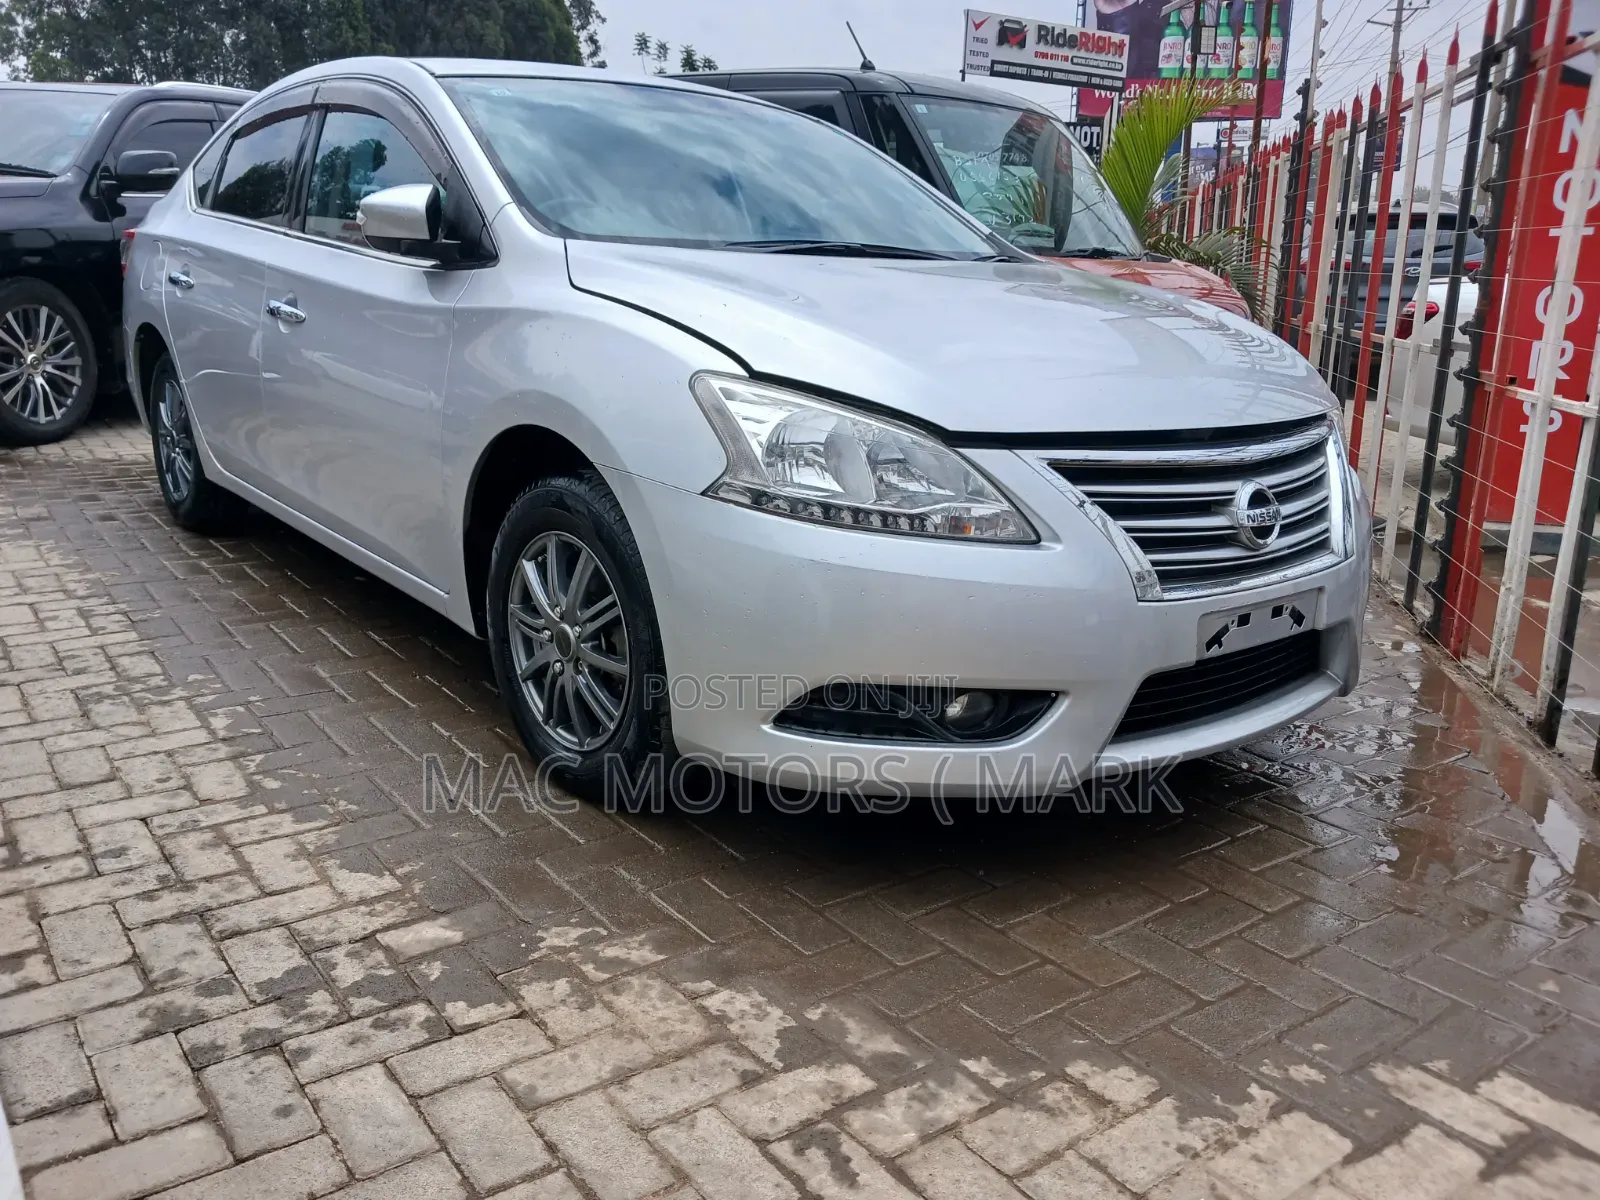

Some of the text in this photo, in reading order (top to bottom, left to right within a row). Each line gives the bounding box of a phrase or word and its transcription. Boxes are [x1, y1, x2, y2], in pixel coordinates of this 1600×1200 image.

[972, 36, 989, 45] TRIED
[1035, 24, 1127, 58] RideRight
[1163, 42, 1182, 51] JINRO
[969, 49, 990, 58] TESTED
[966, 63, 991, 72] TRUSTED
[1070, 126, 1102, 147] MOT
[1246, 507, 1281, 524] NISSAN
